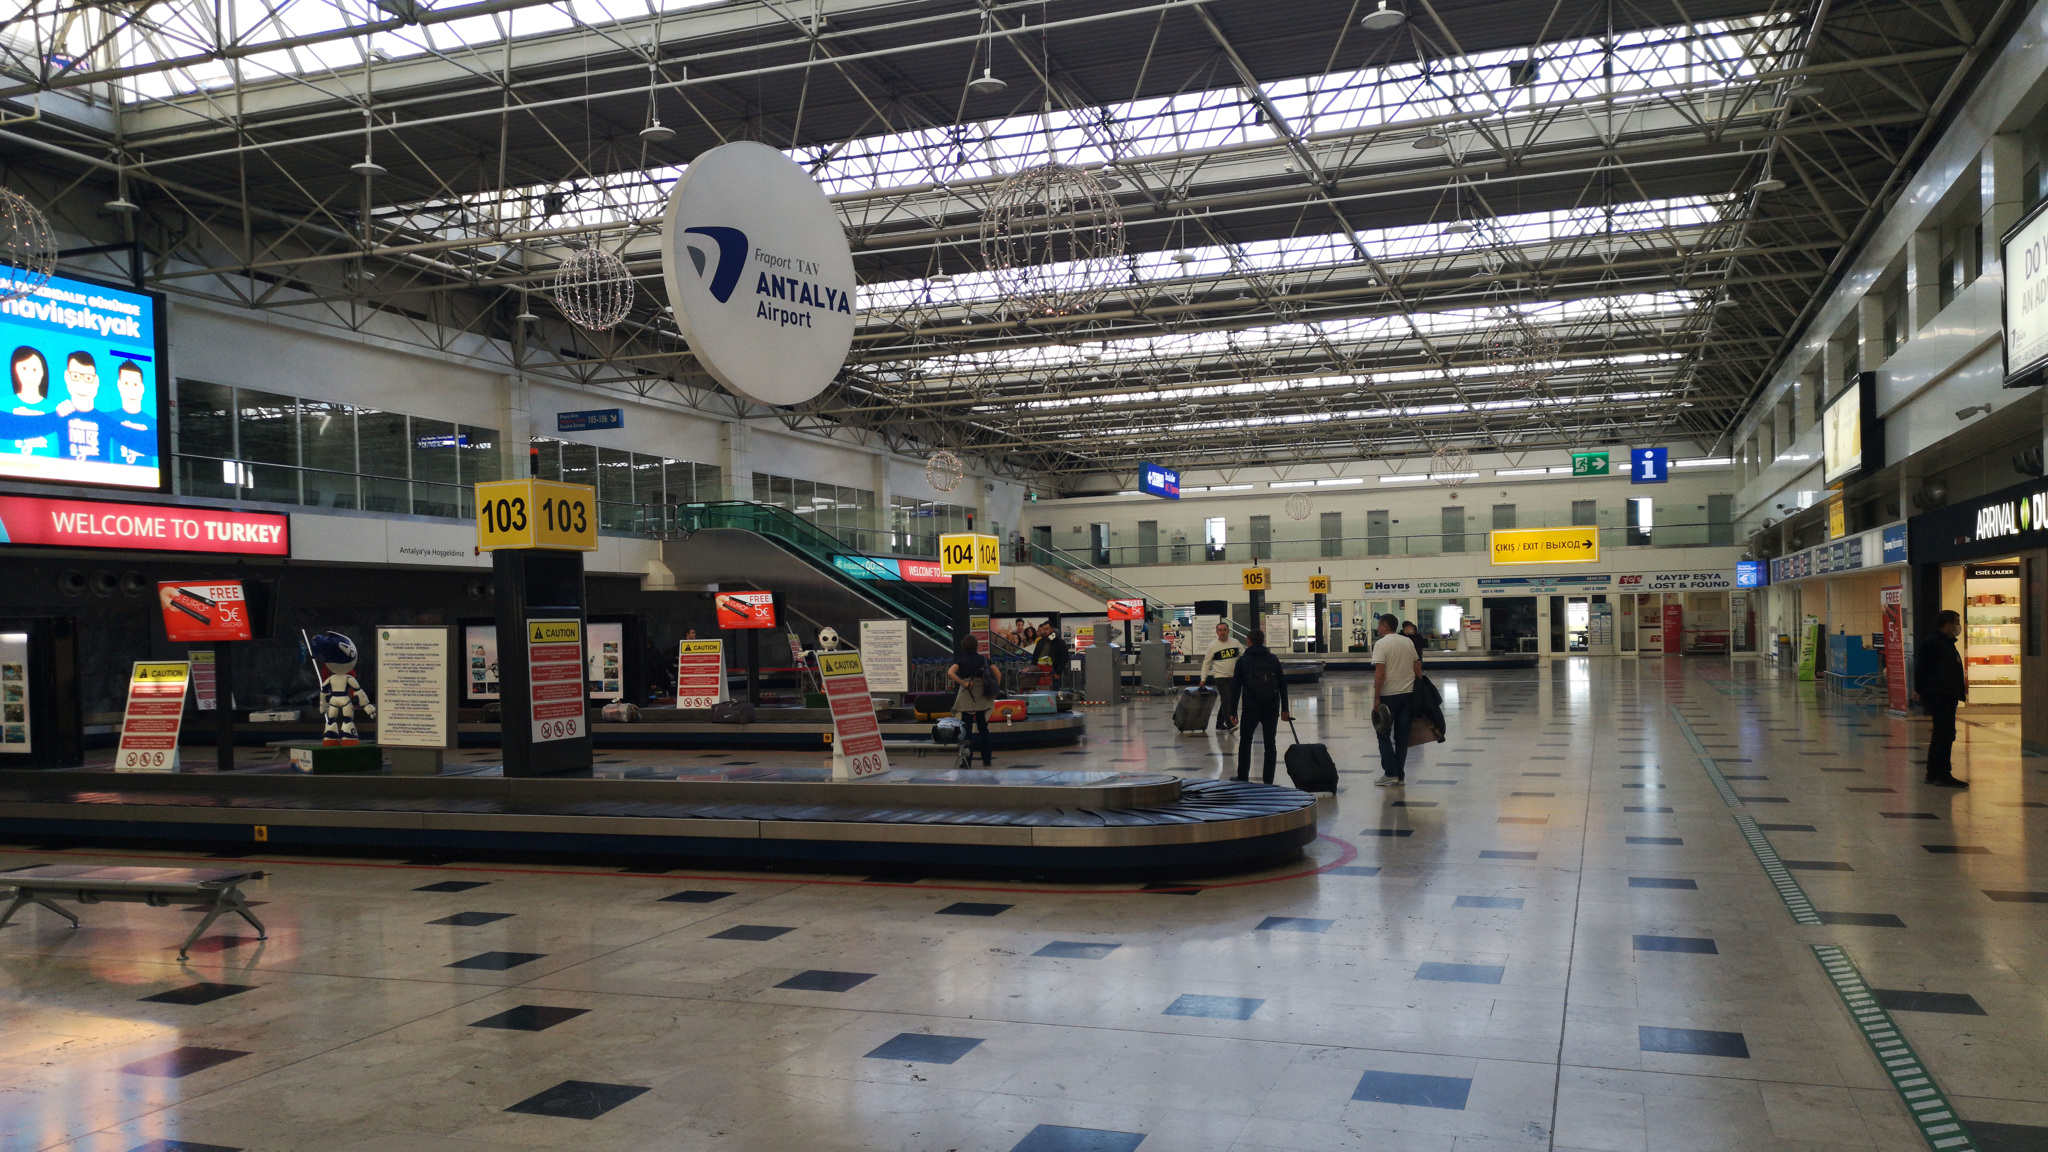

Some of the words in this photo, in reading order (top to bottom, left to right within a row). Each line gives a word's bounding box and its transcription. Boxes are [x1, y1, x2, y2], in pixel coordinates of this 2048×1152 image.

[754, 248, 792, 269] Fraport
[796, 259, 820, 276] TAV
[2025, 241, 2041, 281] DO
[756, 271, 851, 315] ANTALYA
[2022, 286, 2034, 315] AN
[756, 300, 812, 328] Airport
[482, 497, 527, 533] 103
[542, 498, 587, 533] 103
[1975, 500, 2019, 541] ARRIVAL
[51, 511, 166, 538] WELCOME
[170, 518, 199, 539] TO
[203, 520, 282, 543] TURKEY
[400, 547, 431, 556] Antalya'ya
[1495, 543, 1515, 553] ÇIKIŞ
[1523, 542, 1539, 550] EXIT
[1546, 540, 1580, 549] ВЫХОД
[944, 544, 973, 565] 104
[980, 545, 996, 564] 104
[909, 566, 933, 577] WELCOME
[934, 568, 941, 577] TO
[1244, 573, 1263, 585] 105
[1310, 580, 1326, 589] 106
[1375, 582, 1410, 590] Havaş
[209, 587, 239, 599] FREE
[1886, 591, 1900, 603] FREE
[218, 602, 242, 622] 5€
[754, 604, 770, 617] 5€
[545, 629, 576, 638] CAUTION
[1220, 648, 1236, 659] GAP
[834, 659, 860, 670] CAUTION
[151, 669, 184, 678] CAUTION
